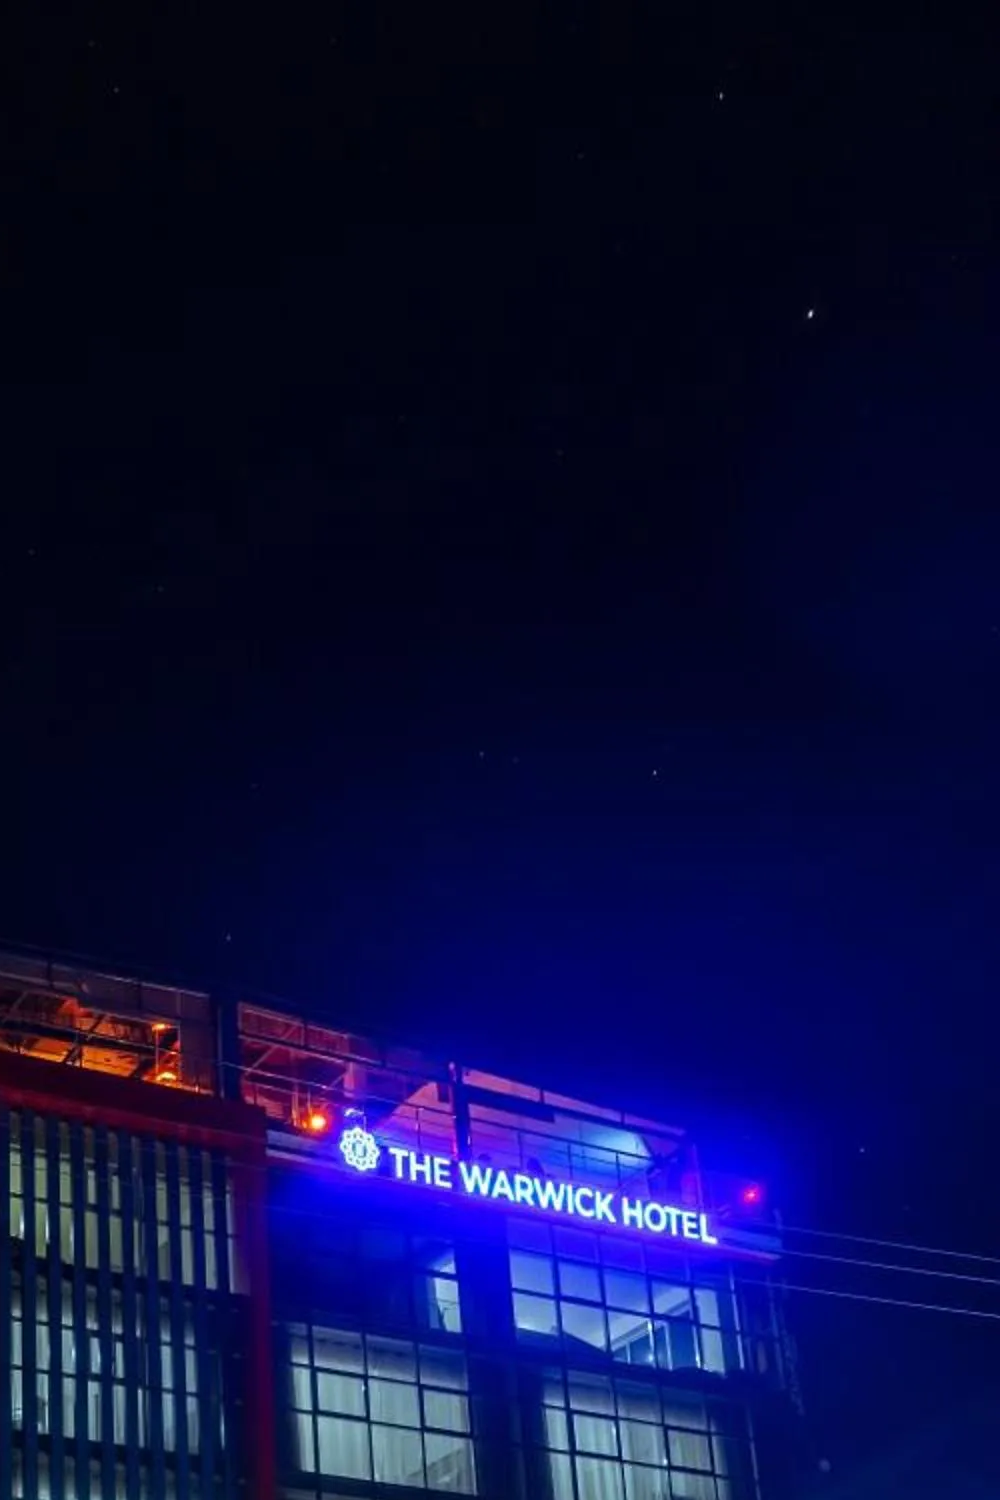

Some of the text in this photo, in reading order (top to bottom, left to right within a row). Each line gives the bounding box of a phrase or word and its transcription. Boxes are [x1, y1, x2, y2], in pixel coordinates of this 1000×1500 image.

[389, 1147, 717, 1244] THE WARWICK HOTEL
